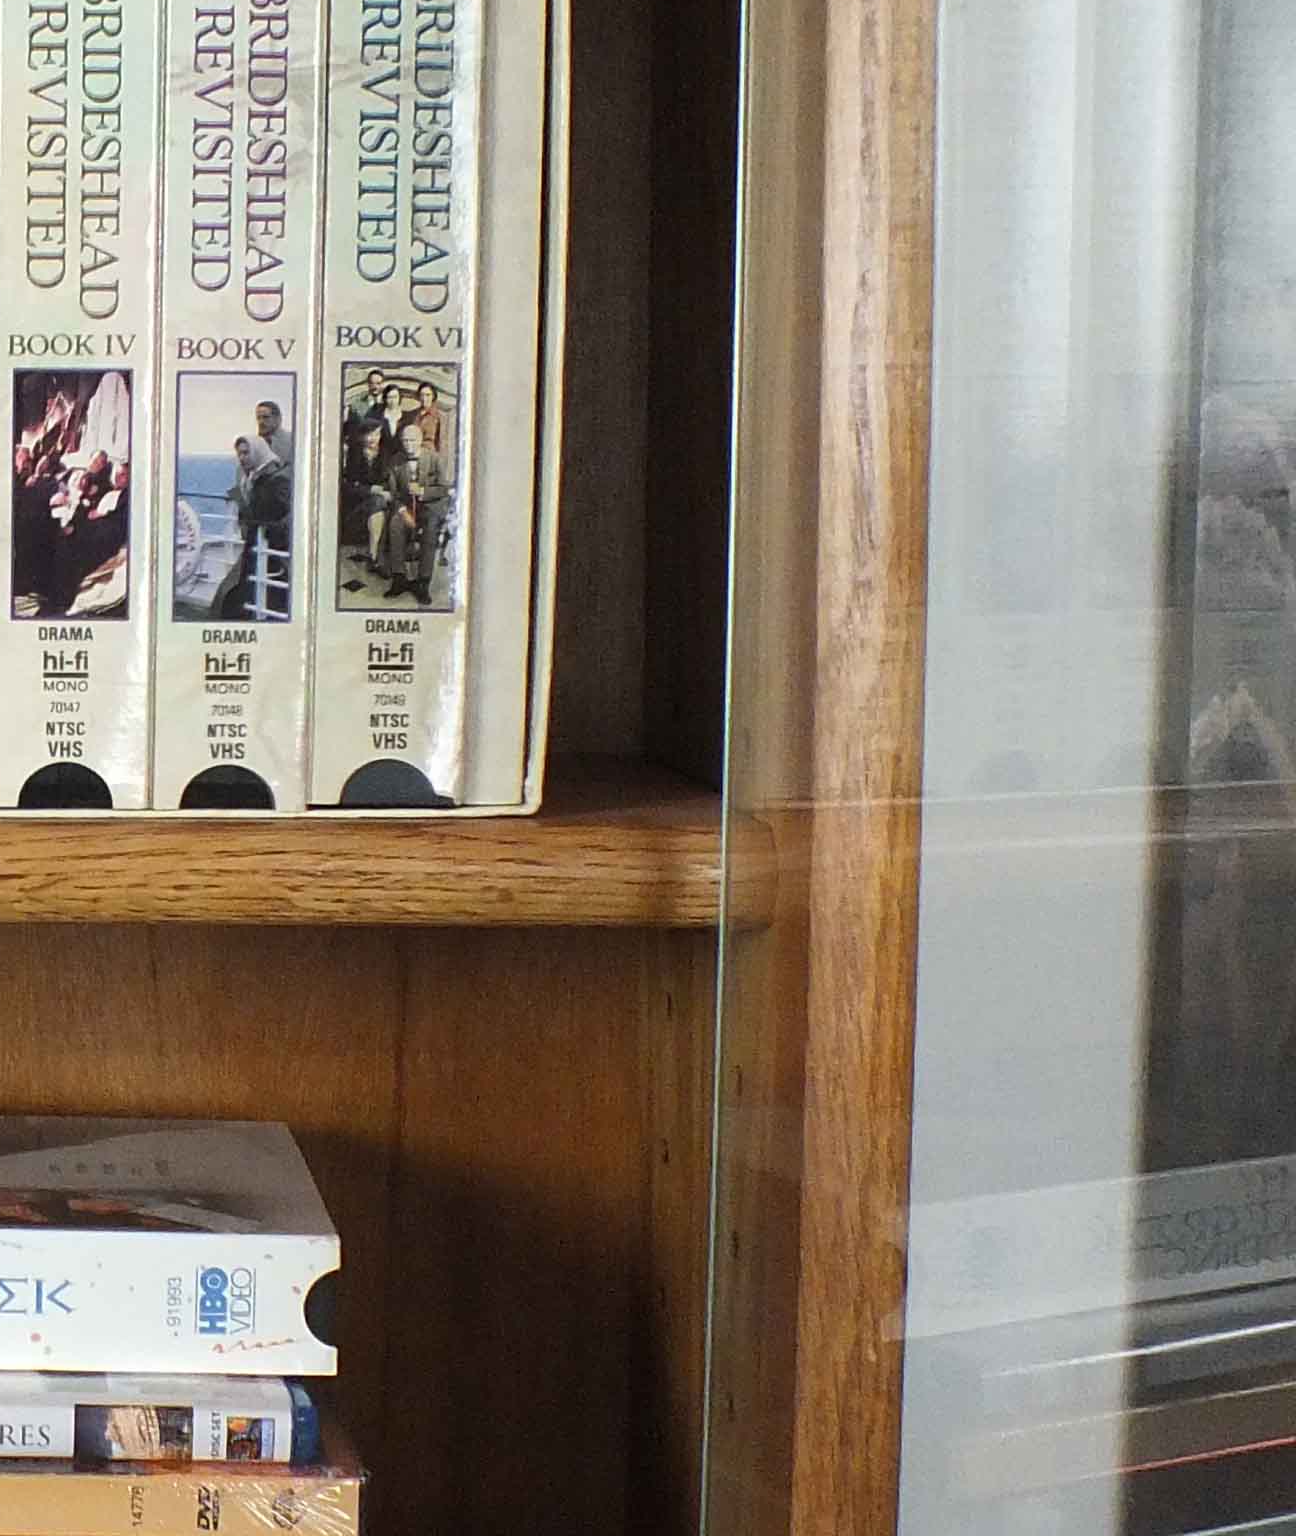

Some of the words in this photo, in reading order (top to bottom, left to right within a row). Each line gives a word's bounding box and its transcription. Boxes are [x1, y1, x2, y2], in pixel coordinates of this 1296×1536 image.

[25, 1, 69, 290] REVISITED
[190, 5, 236, 293] REVISITED
[7, 333, 95, 357] BOOK
[105, 333, 137, 356] IV
[176, 337, 265, 360] BOOK
[274, 338, 296, 359] V
[335, 325, 423, 349] BOOK
[434, 326, 463, 349] VI
[38, 627, 94, 642] DRAMA
[365, 620, 421, 635] DRAMA
[368, 642, 414, 664] hi-fi
[43, 681, 89, 692] MONO
[49, 701, 81, 713] 70147
[48, 741, 83, 758] VHS
[372, 733, 408, 750] VHS
[167, 1276, 182, 1327] 91993
[198, 1267, 229, 1335] HBO
[229, 1267, 253, 1335] VIDEO
[210, 1411, 220, 1431] SET
[196, 1485, 212, 1531] DVD
